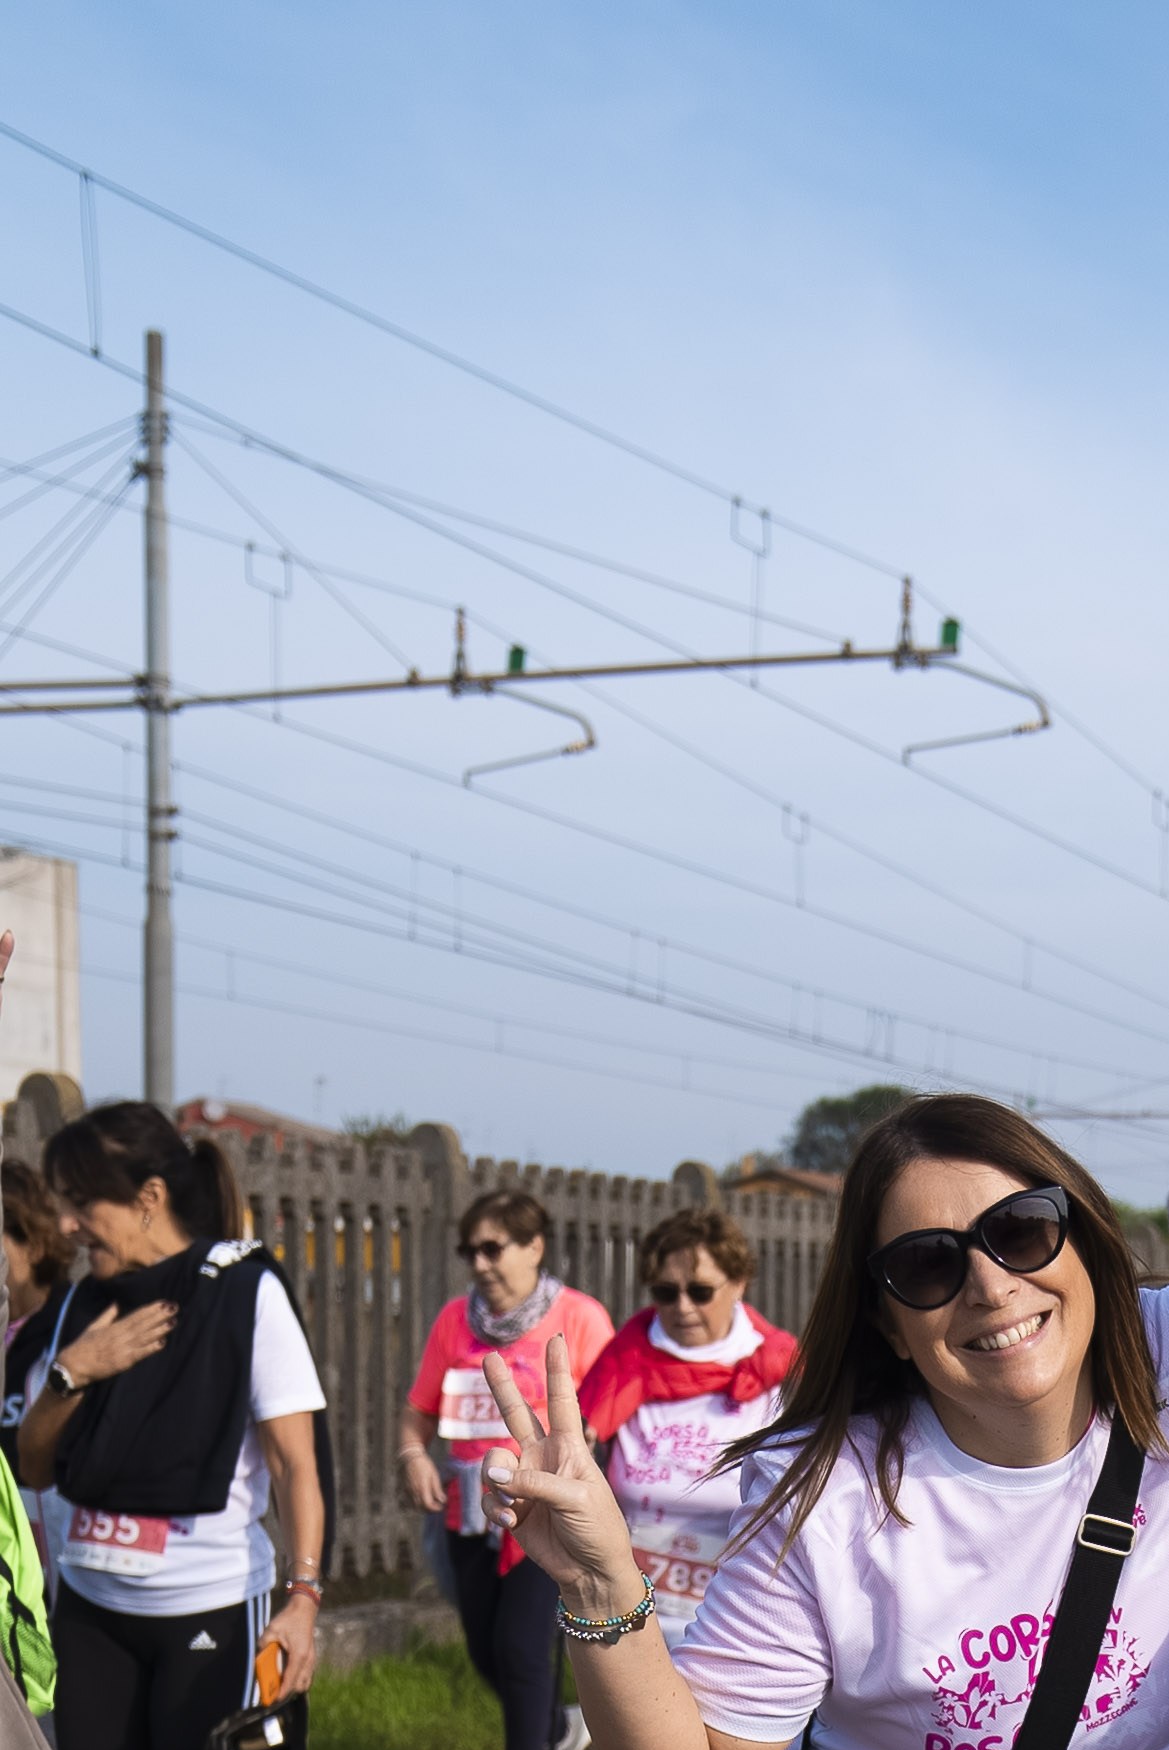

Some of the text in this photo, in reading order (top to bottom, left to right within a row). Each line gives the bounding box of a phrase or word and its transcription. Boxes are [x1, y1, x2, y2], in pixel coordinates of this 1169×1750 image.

[648, 1557, 712, 1598] 789
[922, 1655, 956, 1684] LA
[958, 1613, 1056, 1669] COR
